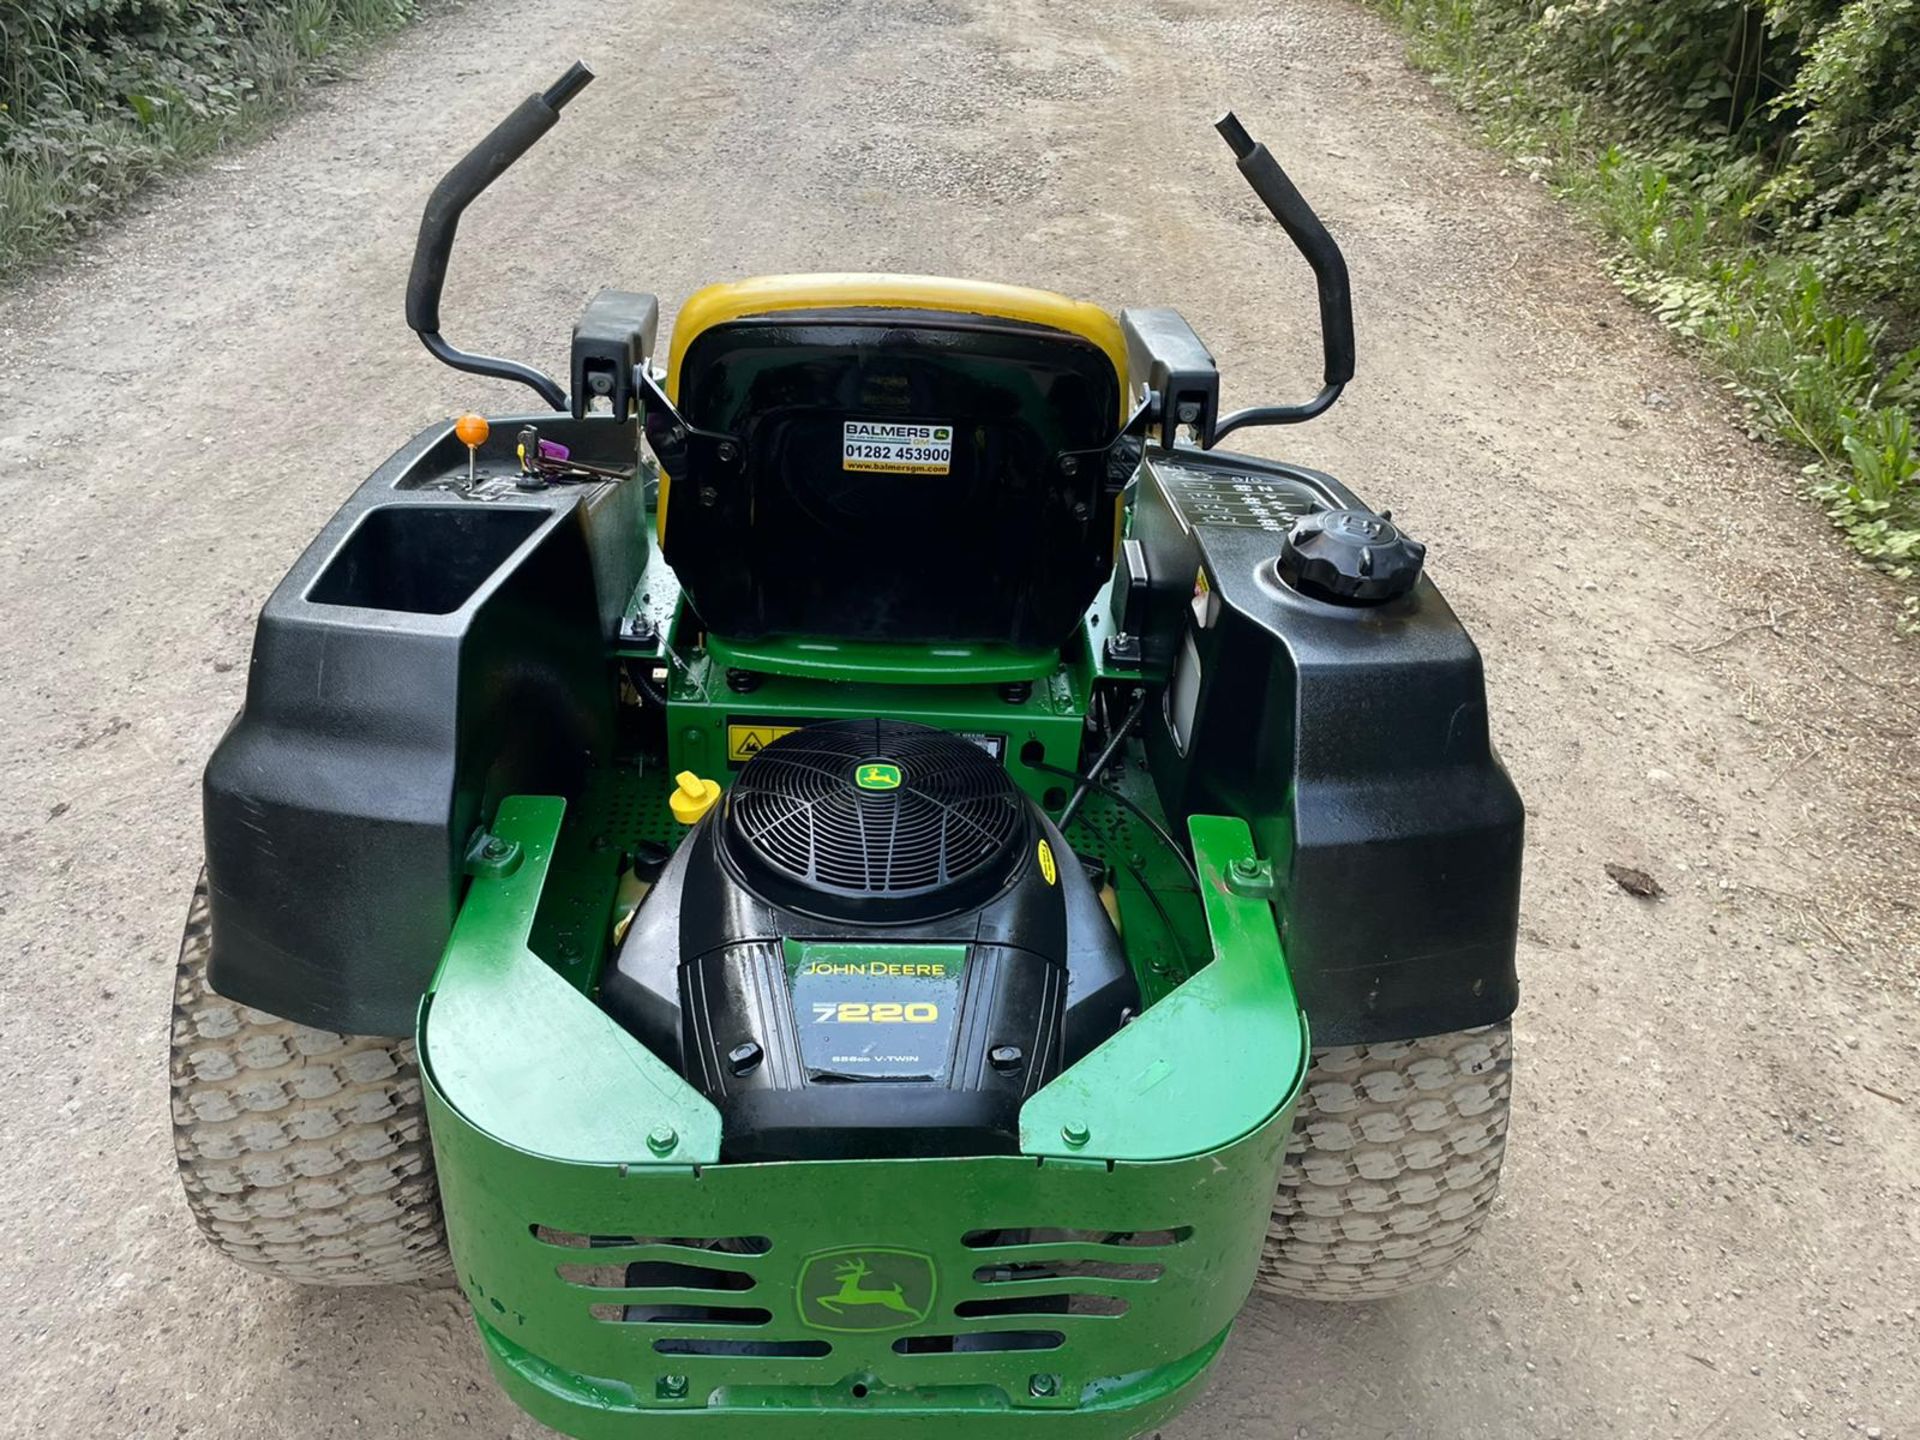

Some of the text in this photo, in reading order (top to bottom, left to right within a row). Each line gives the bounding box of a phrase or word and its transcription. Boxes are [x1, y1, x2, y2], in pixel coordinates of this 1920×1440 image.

[846, 424, 930, 438] BALMERS
[846, 444, 950, 462] 01282 453900
[847, 462, 947, 474] www.balmersgm.com
[803, 961, 946, 976] JOHN DEERE
[874, 1055, 919, 1063] V-TWIN
